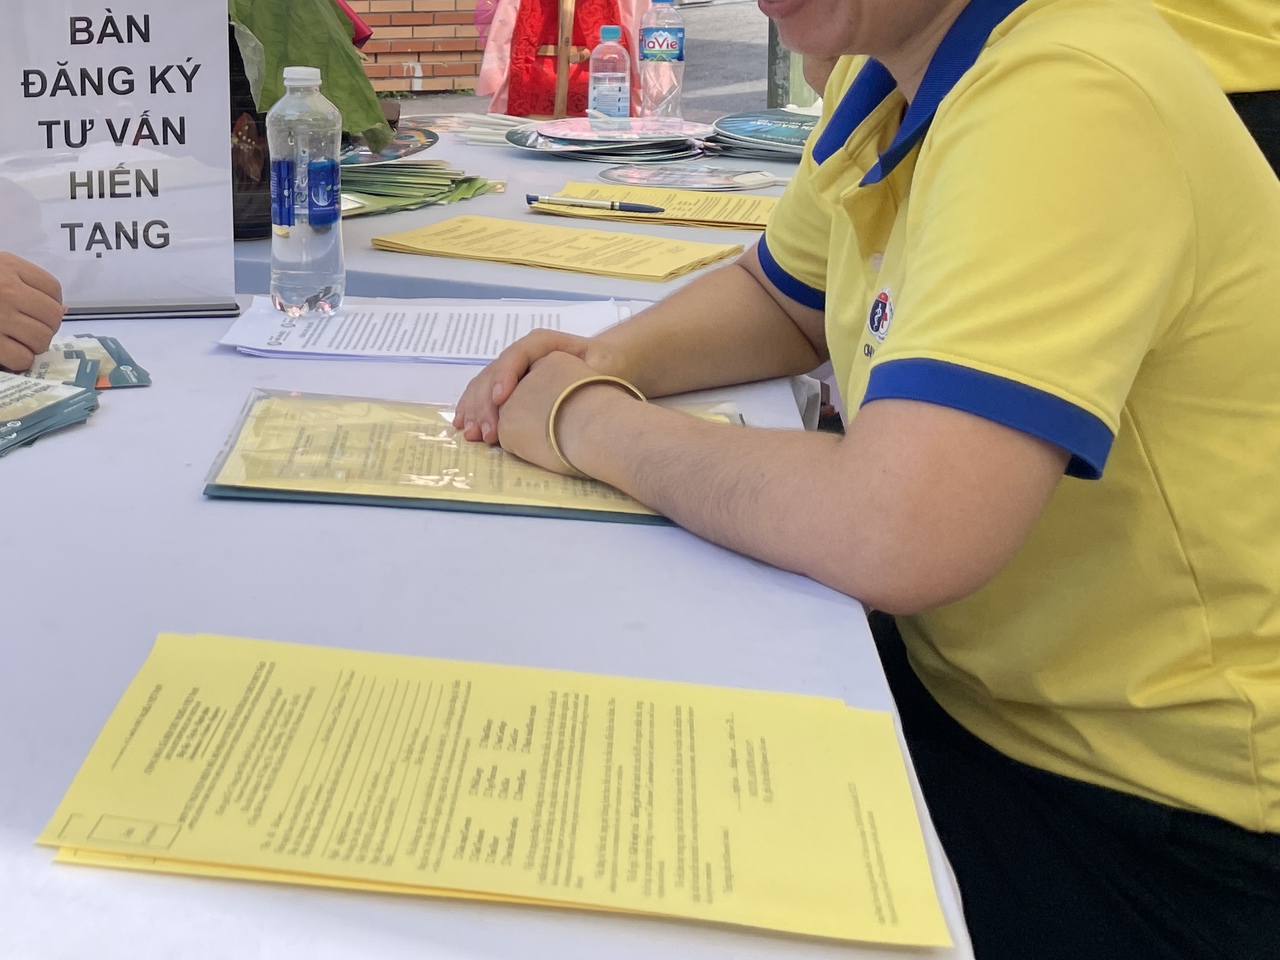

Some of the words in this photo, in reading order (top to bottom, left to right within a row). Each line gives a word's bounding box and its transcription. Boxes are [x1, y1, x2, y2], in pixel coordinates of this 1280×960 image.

[69, 8, 151, 45] BÀN
[21, 60, 135, 98] ĐĂNG
[150, 56, 202, 95] KÝ
[37, 119, 95, 149] TƯ
[105, 110, 187, 147] VẤN
[69, 162, 159, 200] HIẾN
[60, 219, 170, 259] TẠNG
